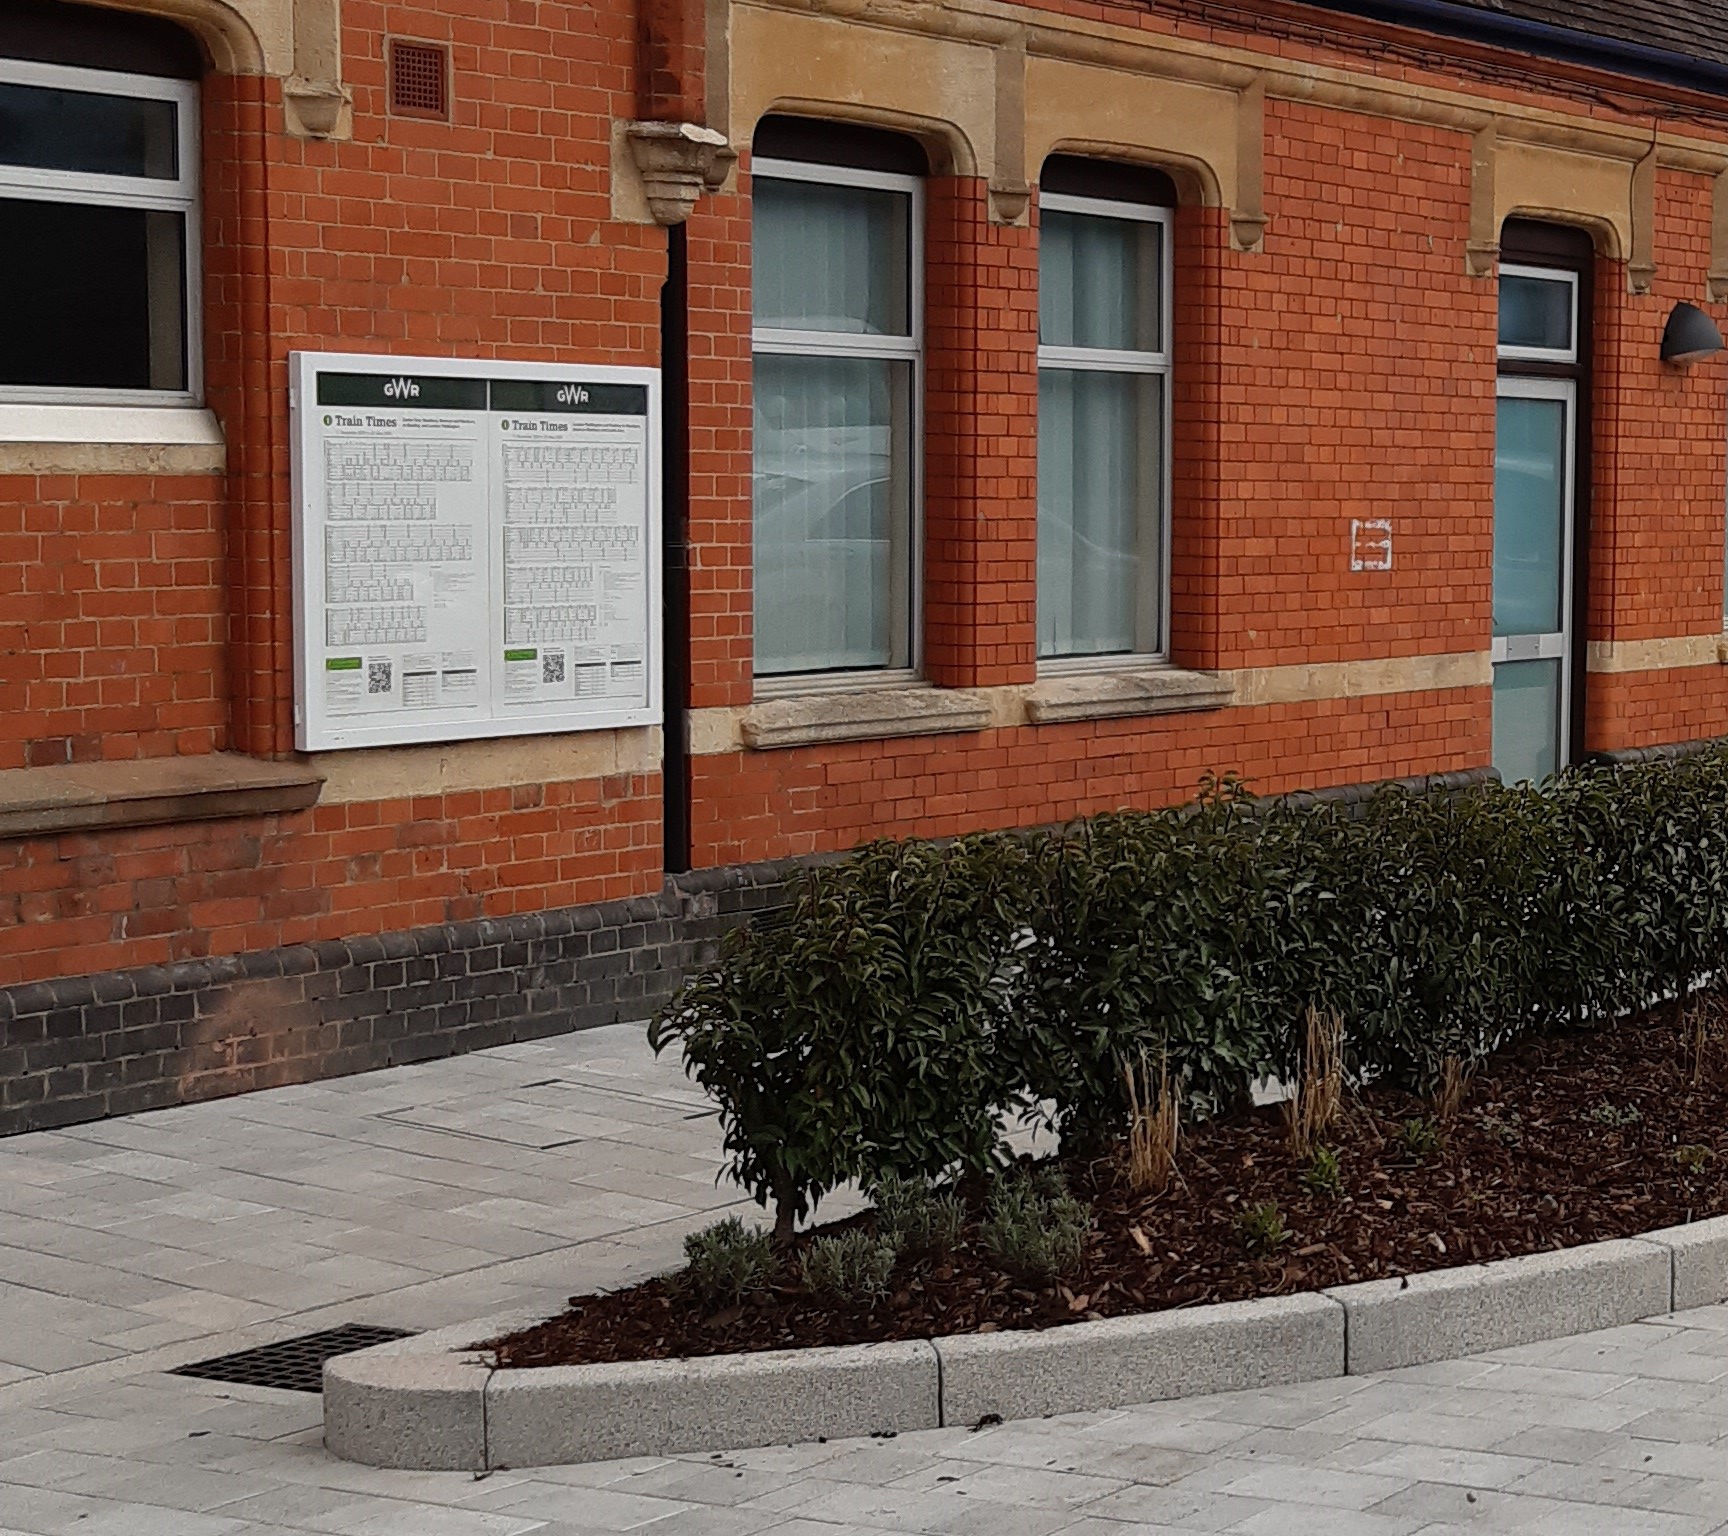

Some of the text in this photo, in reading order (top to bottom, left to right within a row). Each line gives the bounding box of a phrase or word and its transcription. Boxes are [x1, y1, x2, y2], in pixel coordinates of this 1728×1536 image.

[383, 377, 420, 399] GWR
[557, 384, 589, 404] GWR
[335, 415, 363, 427] Train
[366, 416, 397, 428] Times
[512, 419, 537, 431] Train
[540, 421, 568, 431] Times
